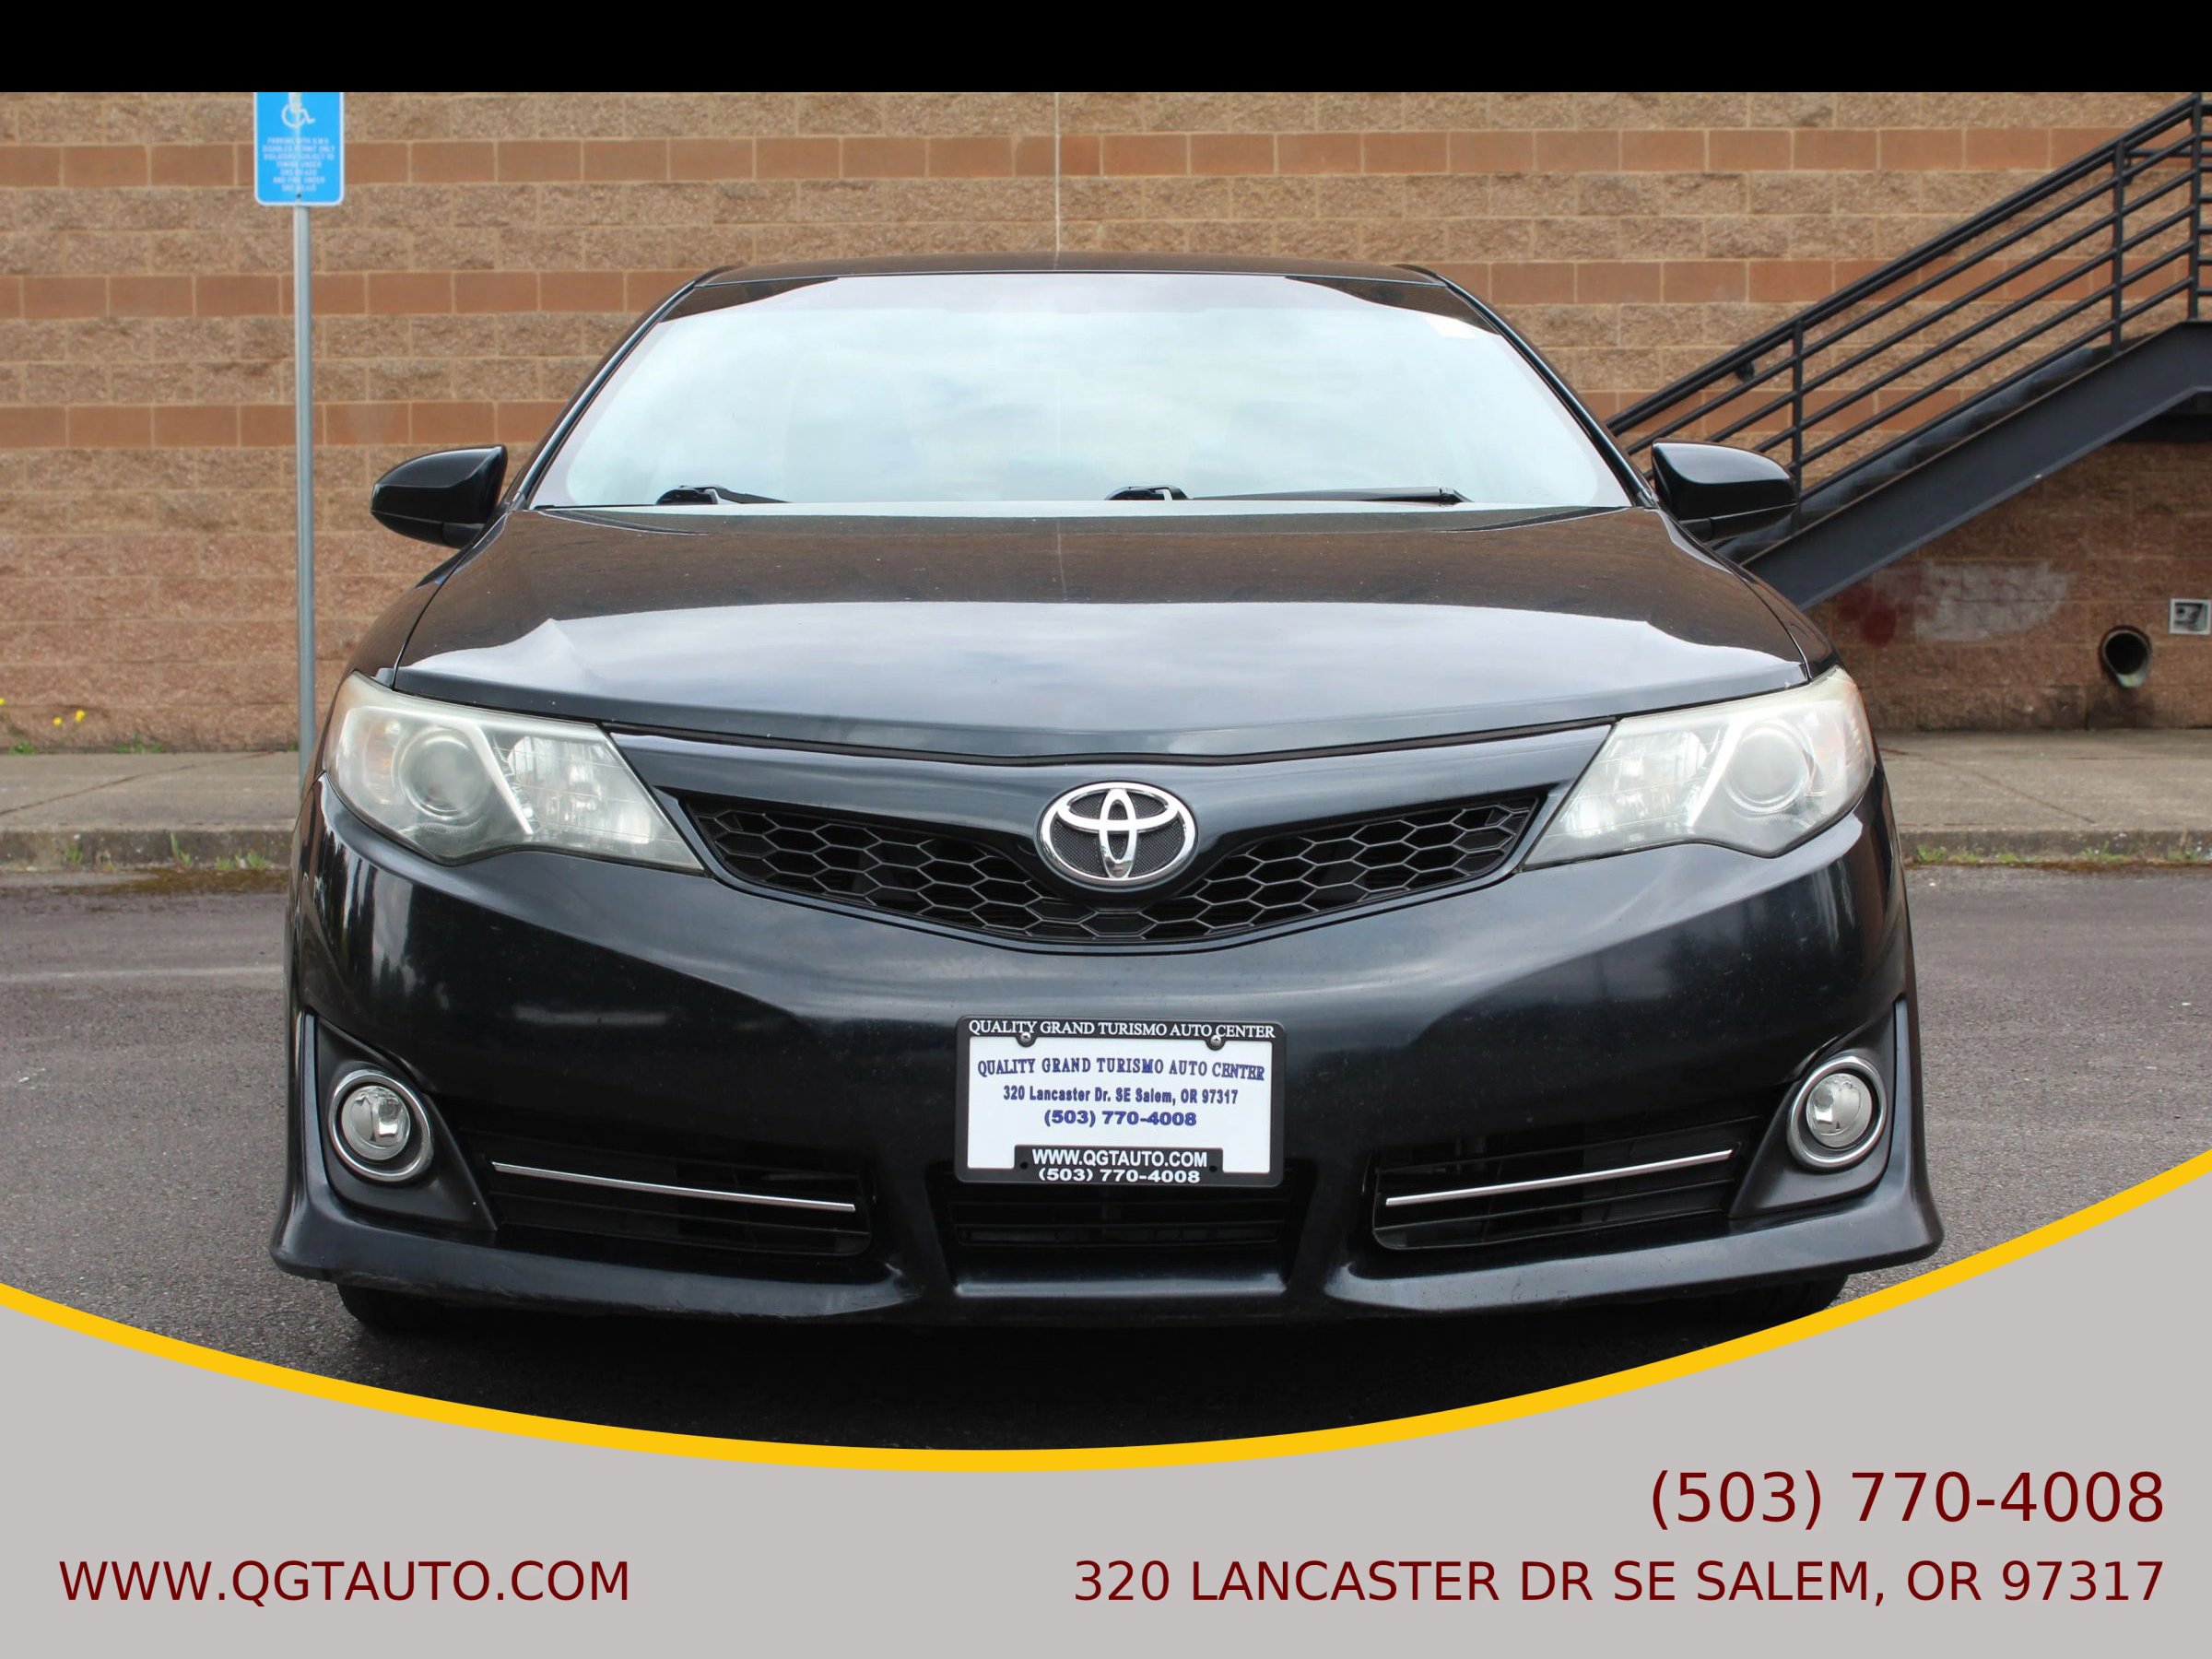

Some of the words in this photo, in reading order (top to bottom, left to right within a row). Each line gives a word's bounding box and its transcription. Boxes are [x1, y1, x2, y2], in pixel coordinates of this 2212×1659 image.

[969, 1019, 1037, 1035] QUALITY
[1040, 1021, 1095, 1035] GRAND
[1098, 1022, 1167, 1036] TURISMO
[1170, 1023, 1212, 1037] AUTO
[1216, 1024, 1276, 1038] CENTER
[977, 1058, 1036, 1077] QUALITY
[1041, 1057, 1091, 1073] GRAND
[1096, 1057, 1164, 1074] TURISMO
[1169, 1060, 1207, 1077] AUTO
[1212, 1062, 1265, 1081] CENTER
[1003, 1085, 1025, 1100] 320
[1030, 1086, 1091, 1101] Lancaster
[1094, 1087, 1112, 1102] Dr.
[1115, 1088, 1131, 1102] SE
[1135, 1088, 1177, 1106] Salem,
[1180, 1088, 1198, 1104] OR
[1201, 1088, 1239, 1104] 97317
[1043, 1110, 1097, 1127] (503)
[1101, 1111, 1197, 1126] 770-4008
[1032, 1148, 1207, 1168] WWW.QGTAUTO.COM
[1038, 1168, 1094, 1182] (503)
[1100, 1169, 1200, 1183] 770-4008
